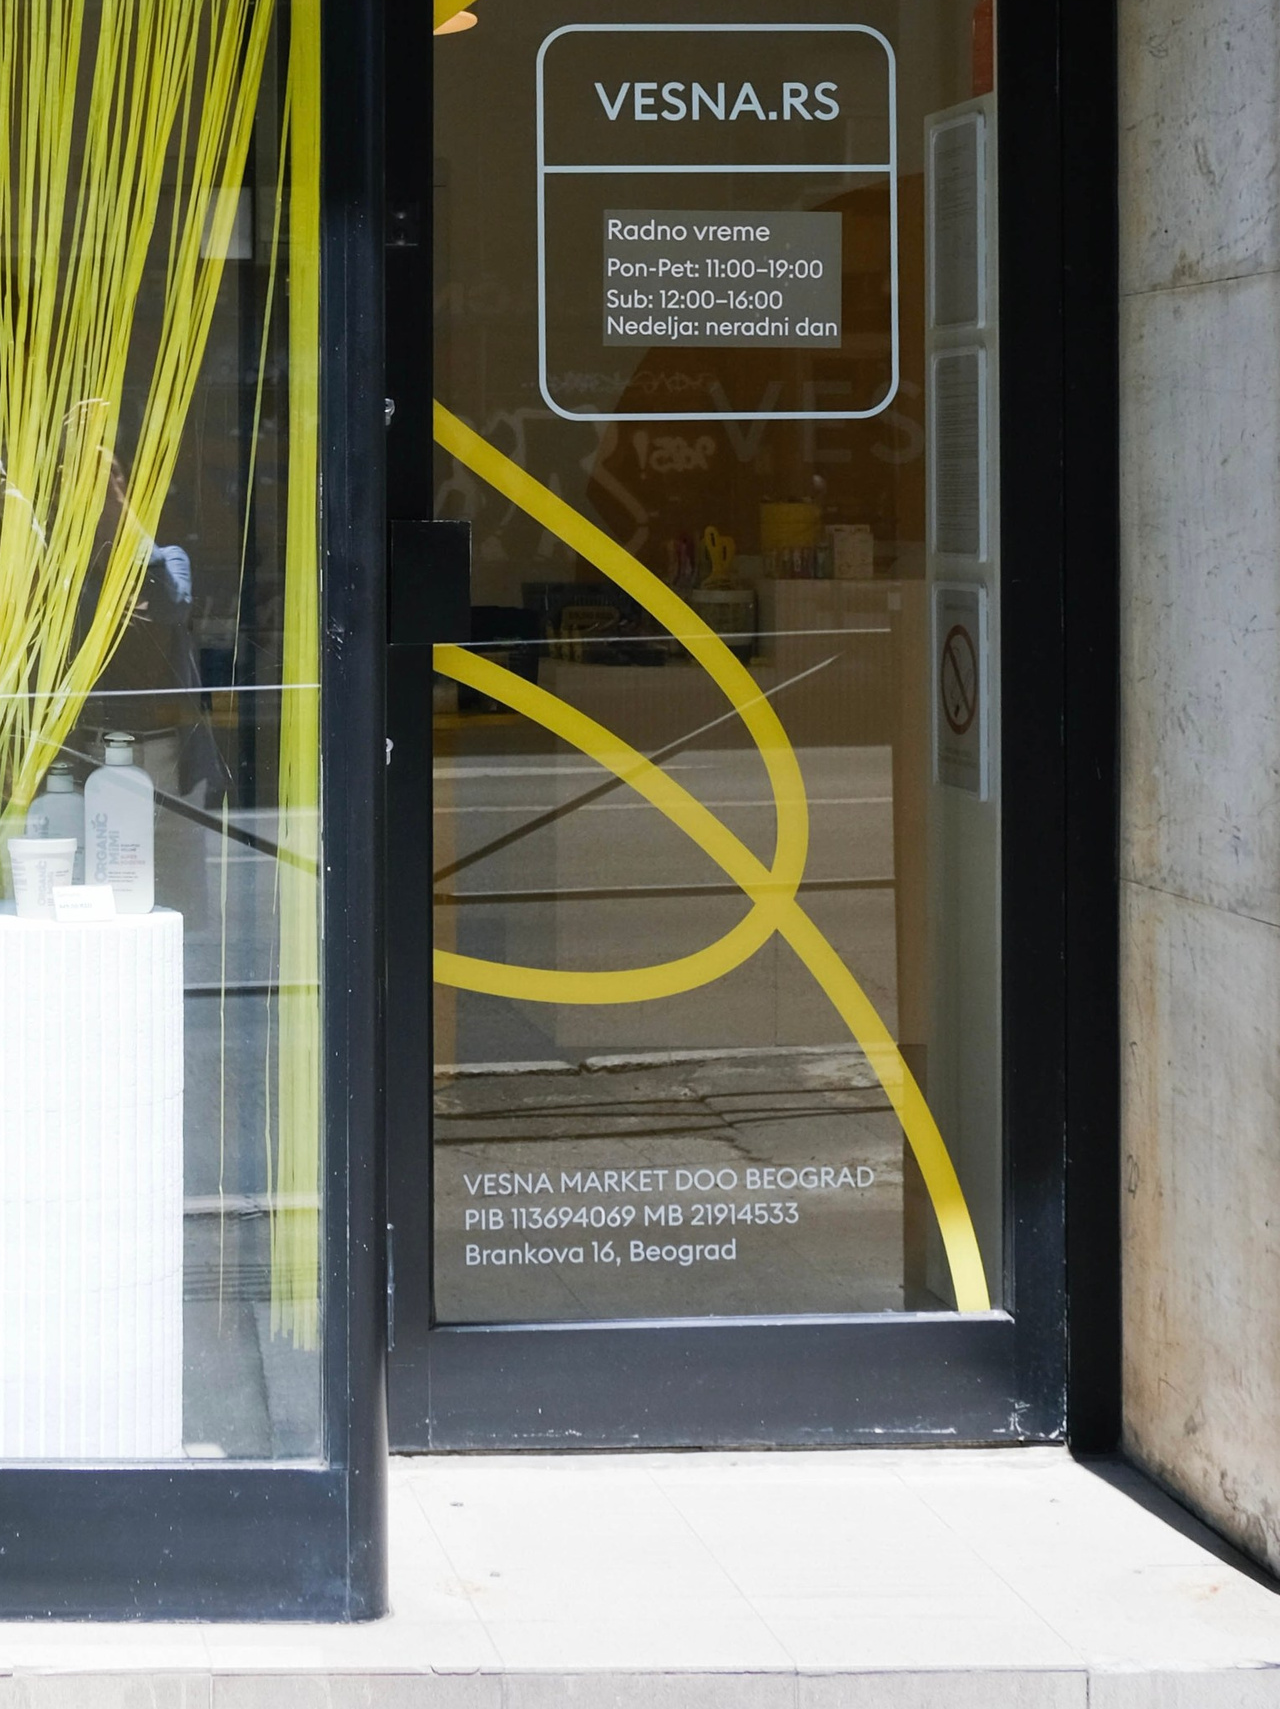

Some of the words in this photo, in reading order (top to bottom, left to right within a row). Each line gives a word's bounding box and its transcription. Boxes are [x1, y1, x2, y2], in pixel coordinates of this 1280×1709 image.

[595, 82, 840, 121] VESNA.RS
[607, 219, 687, 241] Radno
[694, 225, 771, 242] vreme
[607, 258, 700, 278] Pon-Pet:
[606, 289, 654, 309] Sub:
[606, 316, 700, 340] Nedelja:
[706, 317, 789, 336] neradni
[796, 317, 838, 337] dan
[90, 812, 108, 883] ORGANIC
[463, 1172, 554, 1195] VESNA
[560, 1170, 669, 1194] MARKET
[675, 1168, 737, 1192] DOO
[746, 1166, 875, 1190] BEOGRAD
[465, 1208, 504, 1230] PIB
[511, 1205, 636, 1229] 113694069
[644, 1205, 683, 1227] MB
[691, 1202, 800, 1226] 21914533
[465, 1242, 584, 1266] Brankova
[592, 1240, 621, 1266] 16,
[630, 1238, 737, 1267] Beograd
